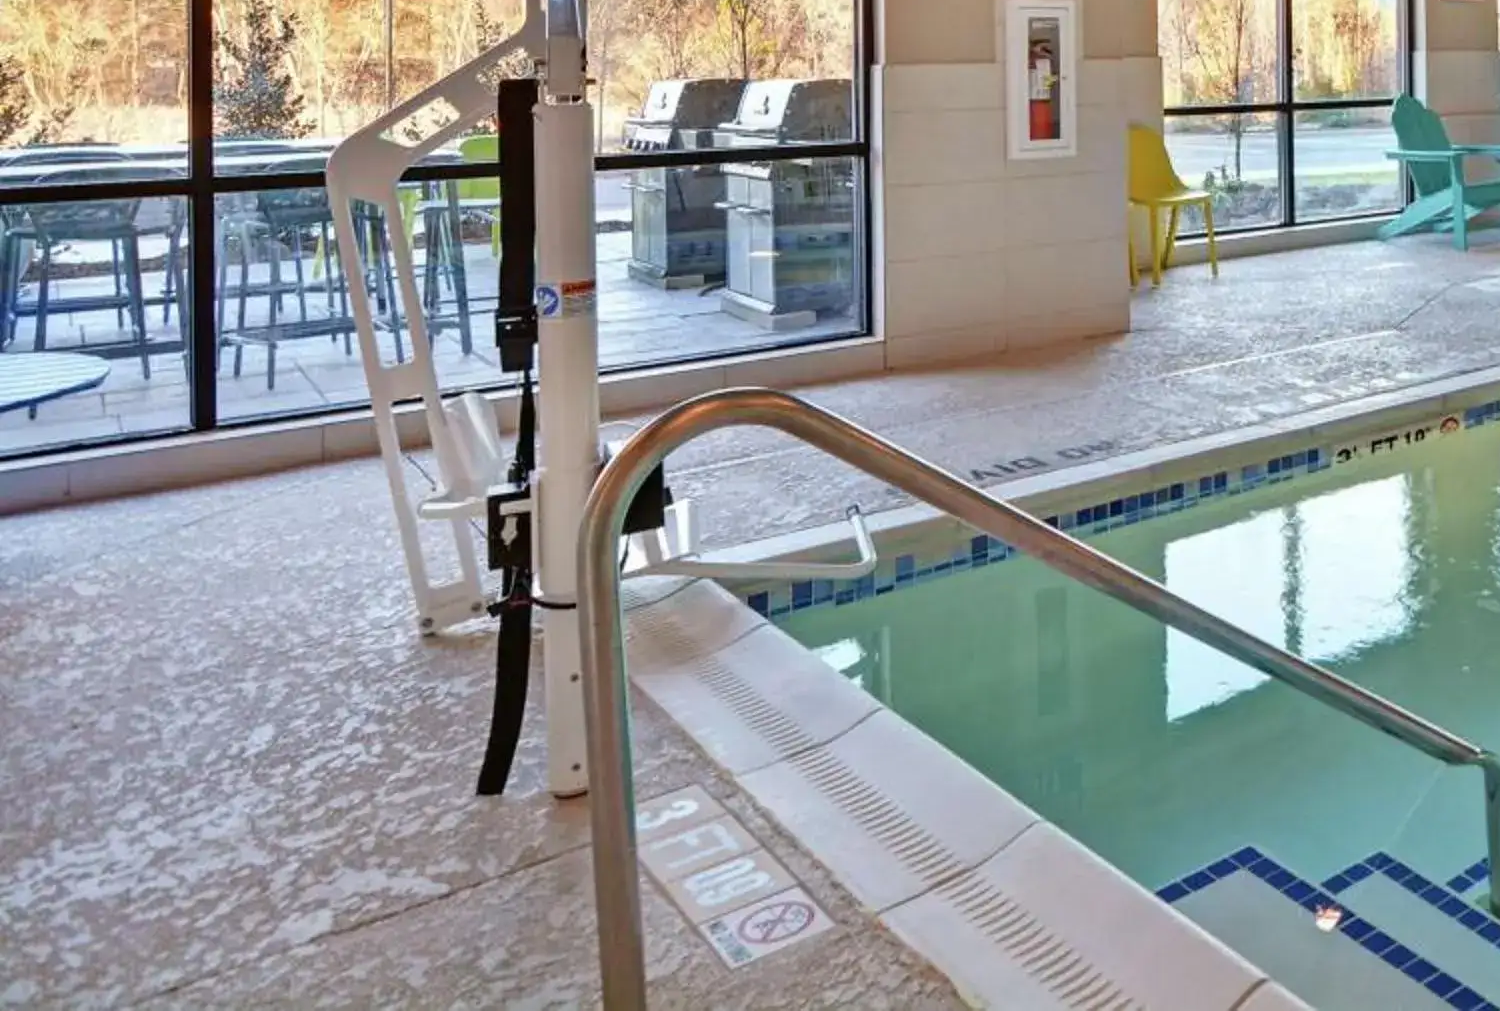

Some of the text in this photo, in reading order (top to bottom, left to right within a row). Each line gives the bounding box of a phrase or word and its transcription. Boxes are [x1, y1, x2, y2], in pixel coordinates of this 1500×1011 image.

[1370, 434, 1399, 454] FT
[636, 798, 699, 831] 3
[649, 822, 741, 870] FT
